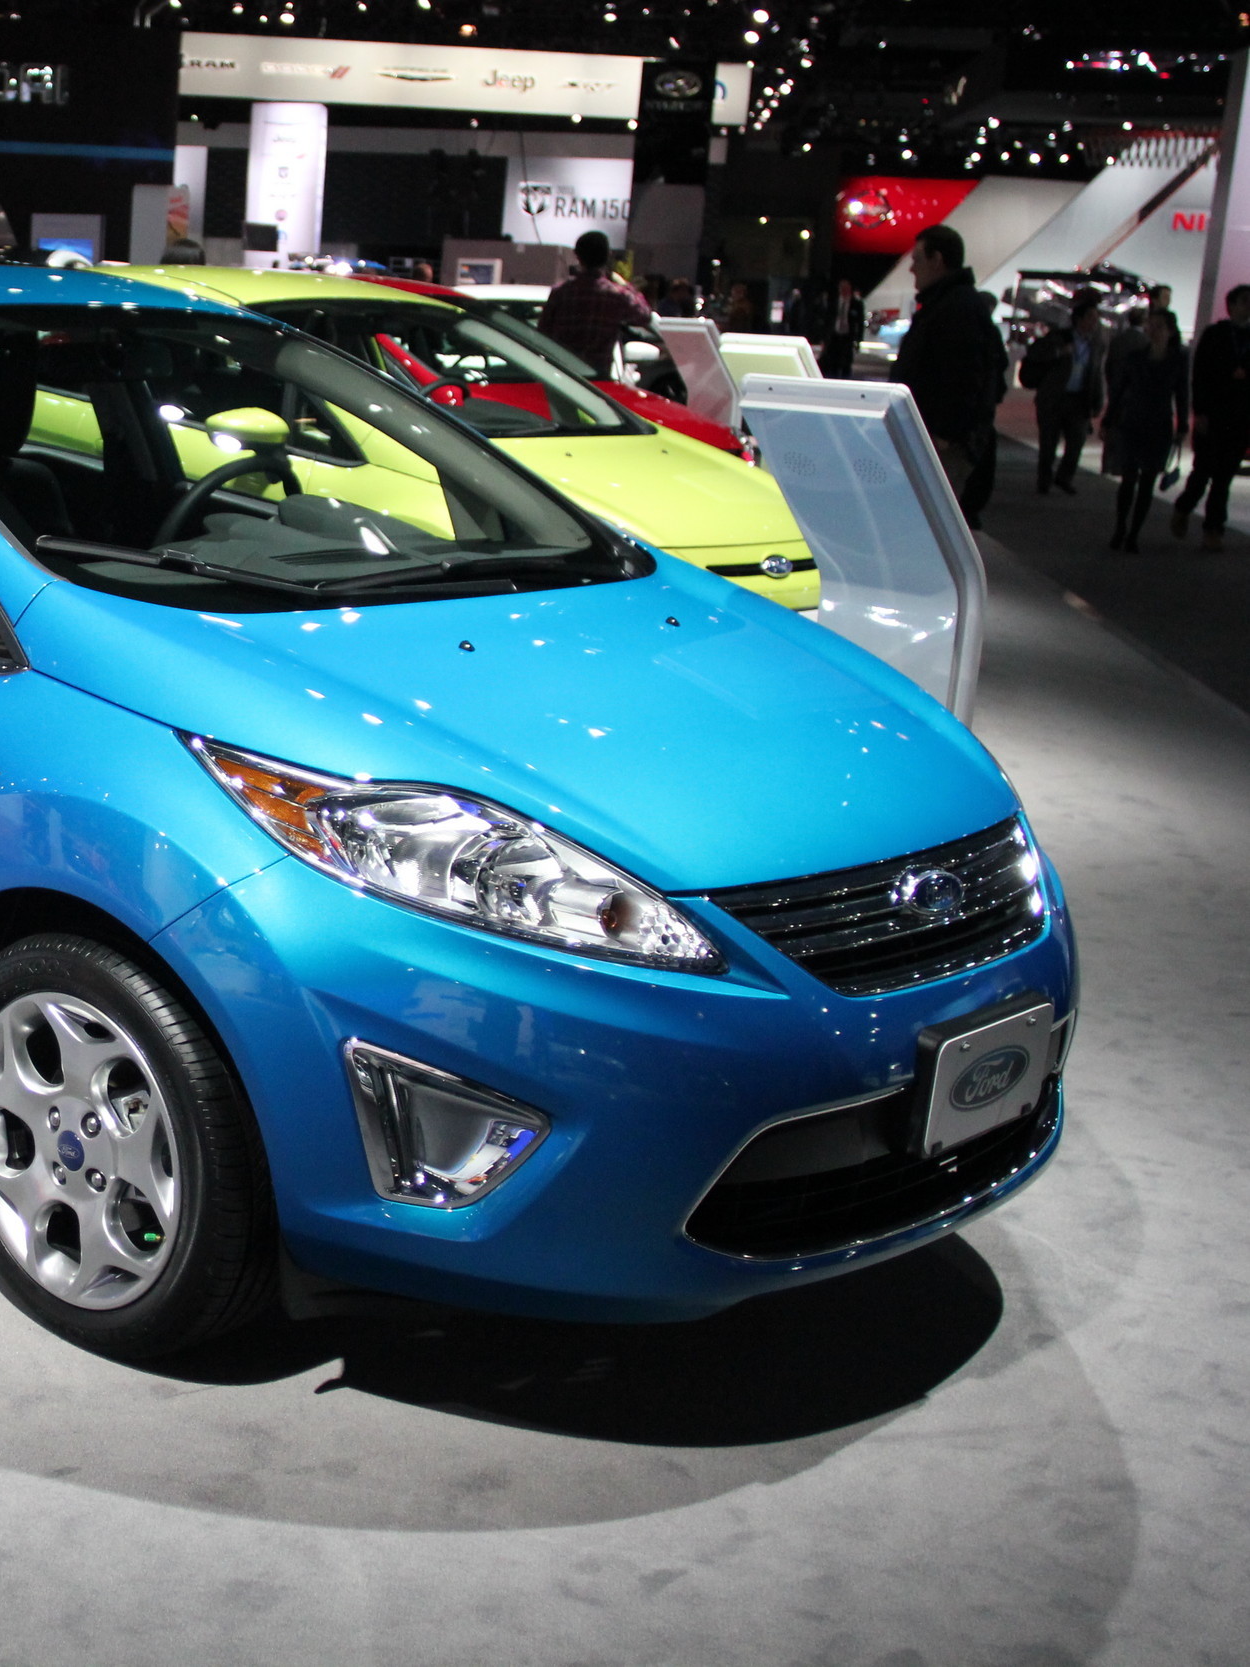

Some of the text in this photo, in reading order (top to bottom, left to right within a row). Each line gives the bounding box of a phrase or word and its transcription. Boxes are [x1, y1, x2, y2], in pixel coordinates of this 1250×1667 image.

[189, 59, 236, 70] RAM
[484, 69, 535, 92] Jeep
[554, 197, 596, 218] RAM
[965, 1057, 1015, 1103] Ford
